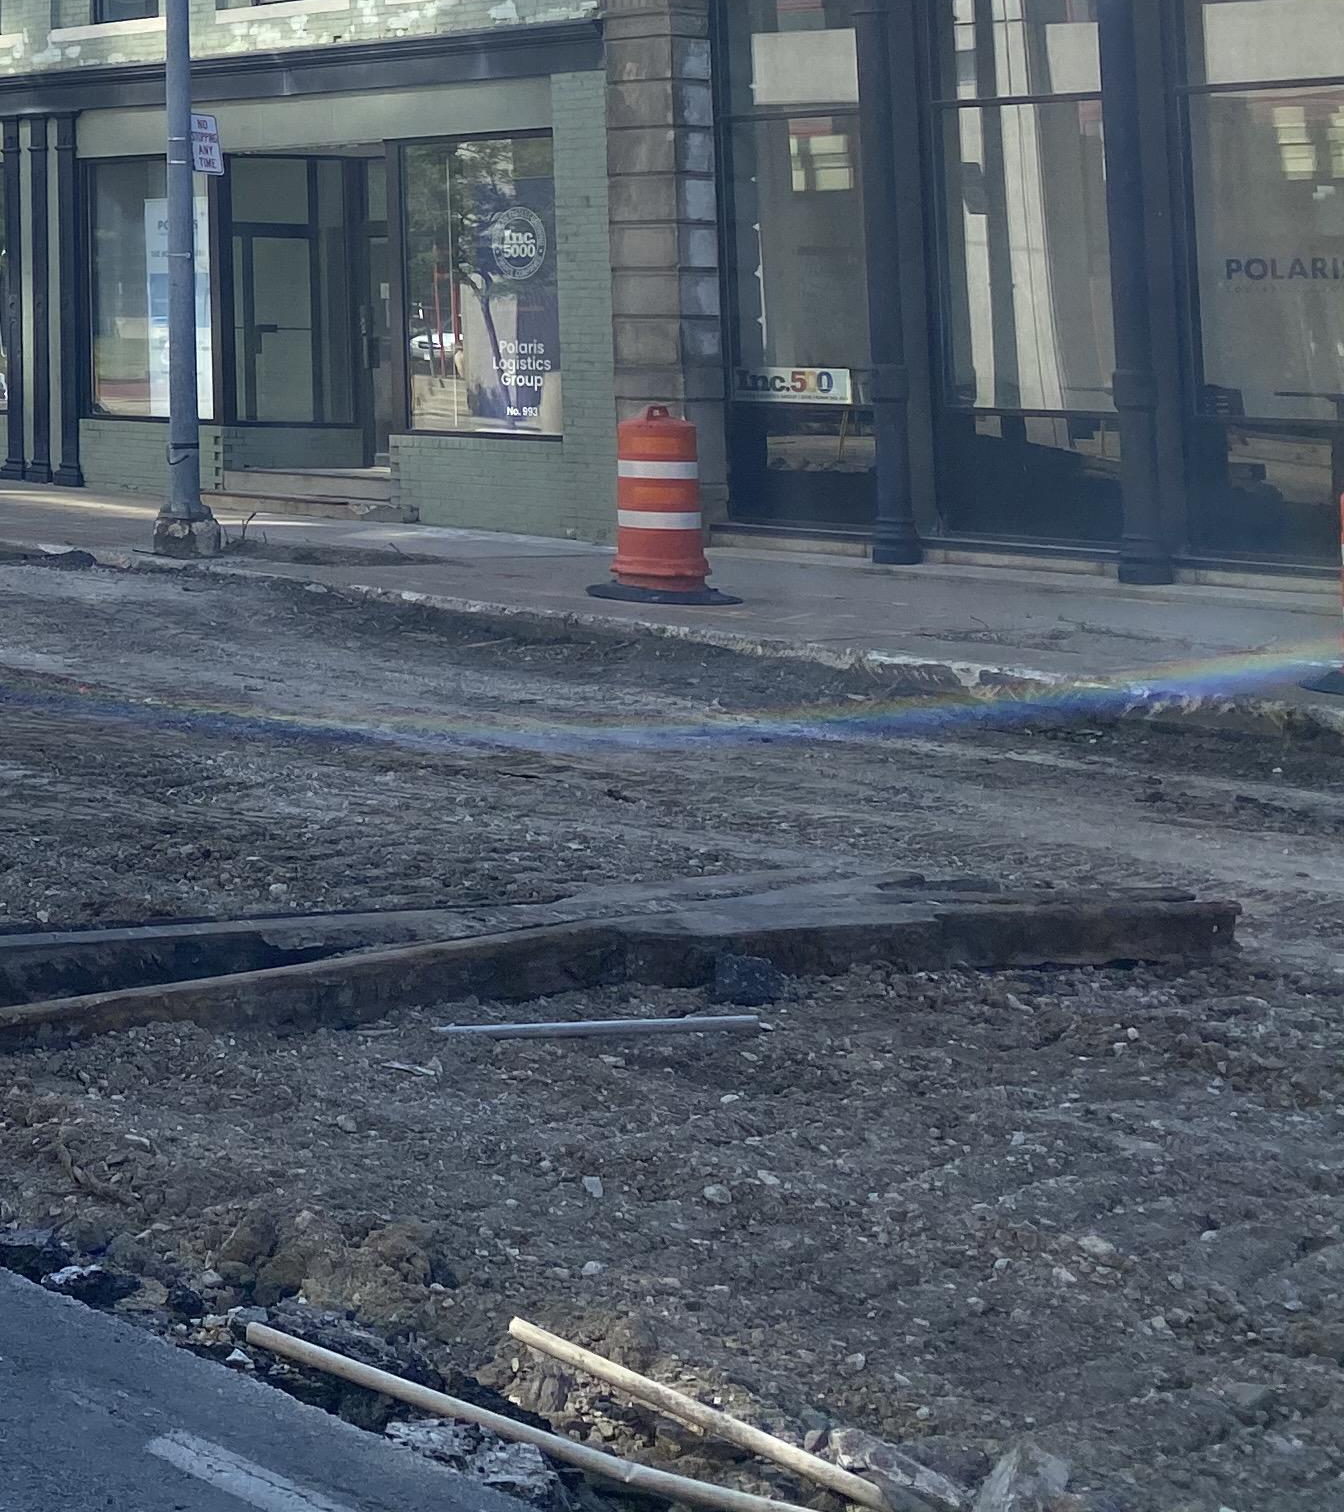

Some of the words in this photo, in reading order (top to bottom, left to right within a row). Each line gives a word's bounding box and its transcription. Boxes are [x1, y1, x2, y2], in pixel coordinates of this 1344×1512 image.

[196, 119, 209, 130] NO
[198, 144, 214, 157] ANY
[199, 157, 218, 169] TIME
[503, 229, 536, 244] Inc.
[503, 243, 536, 258] 5000
[1225, 257, 1344, 281] POLARI
[499, 338, 545, 355] Polaris
[492, 355, 552, 375] Logistics
[501, 372, 544, 392] Group
[506, 406, 521, 416] No.
[522, 406, 538, 416] 993
